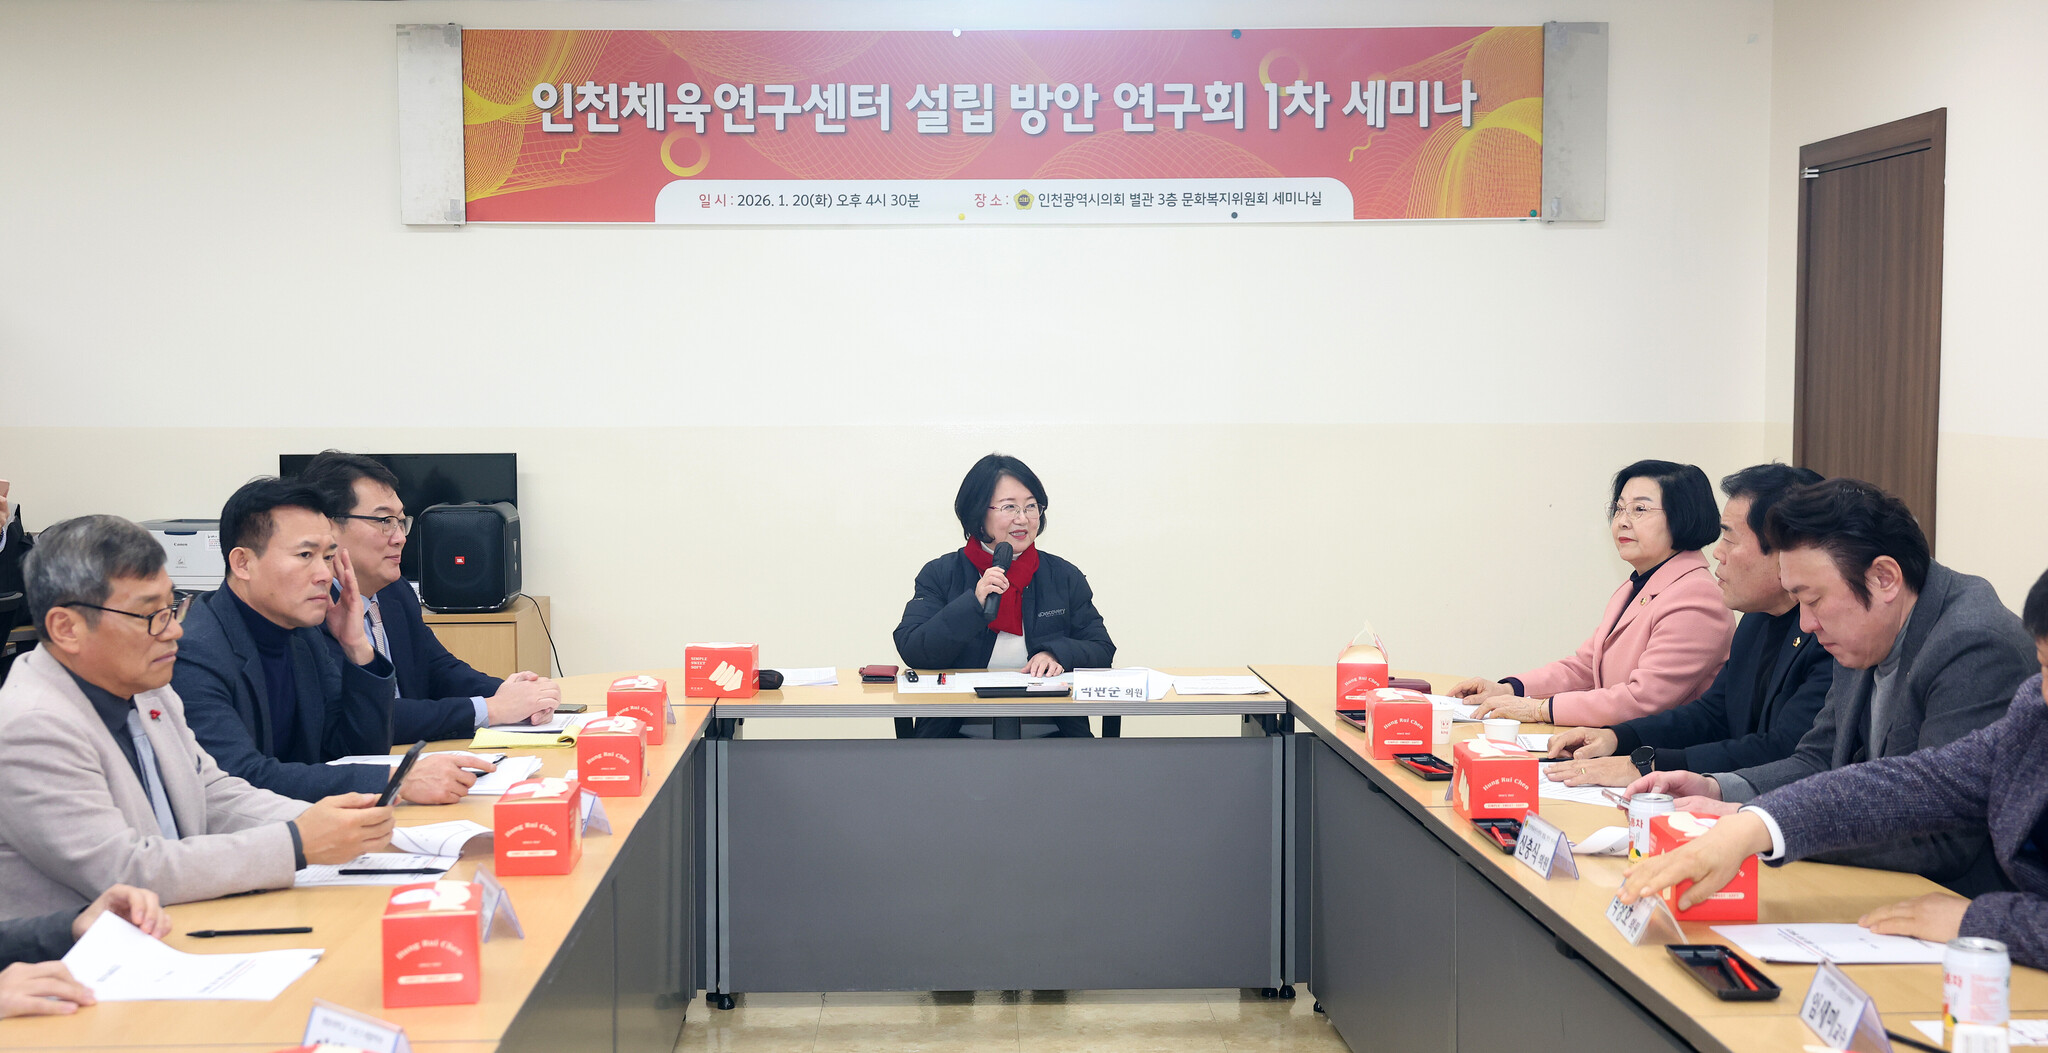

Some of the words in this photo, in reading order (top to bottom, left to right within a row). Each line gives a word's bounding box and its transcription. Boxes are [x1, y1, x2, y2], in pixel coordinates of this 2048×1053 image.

[532, 80, 890, 134] 인천체육연구센터
[905, 82, 993, 134] 설립
[1009, 82, 1099, 135] 방안
[1112, 80, 1244, 132] 연구회
[1263, 79, 1331, 130] 1차
[1342, 79, 1478, 128] 세미나
[737, 194, 775, 207] 2026.
[778, 194, 789, 207] 1.
[792, 193, 833, 209] 20(화)
[836, 193, 863, 208] 오후
[865, 193, 886, 207] 4시
[890, 193, 921, 208] 30분
[1038, 192, 1125, 208] 인천광역시의회
[1129, 192, 1155, 208] 별관
[1157, 192, 1179, 208] 3층
[1181, 191, 1268, 207] 문화복지위원회
[1272, 191, 1322, 207] 세미나실
[1125, 687, 1143, 698] 의원
[1383, 719, 1399, 730] Hung
[1410, 719, 1424, 730] Chen
[1482, 779, 1500, 792] Hung
[1514, 778, 1530, 791] Chen
[1518, 834, 1541, 865] 신충식
